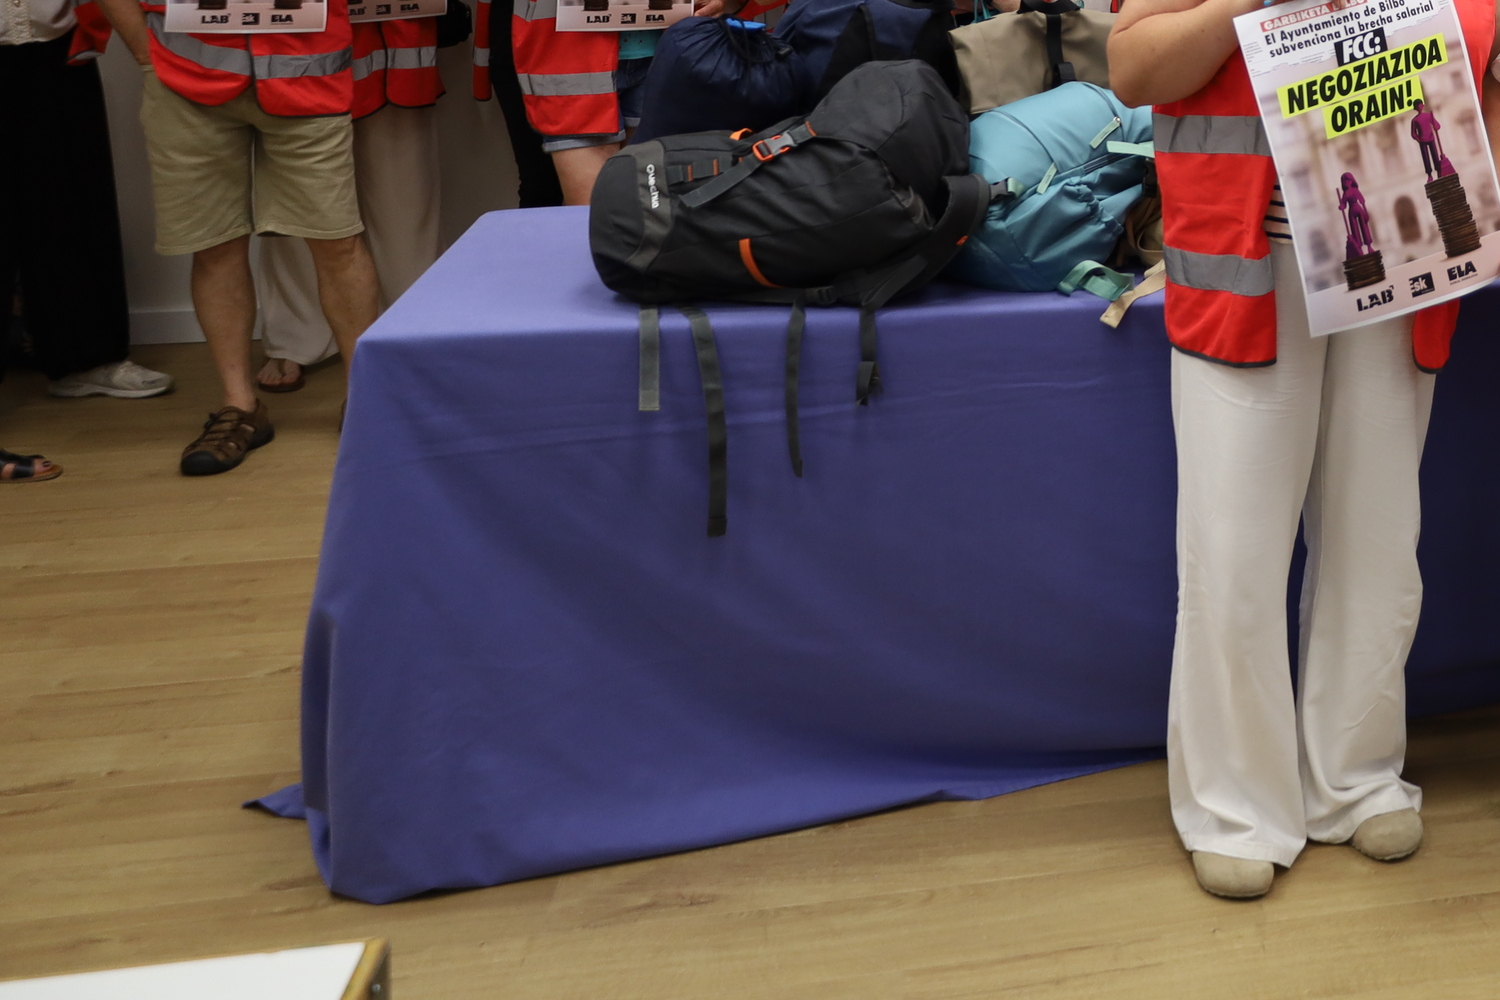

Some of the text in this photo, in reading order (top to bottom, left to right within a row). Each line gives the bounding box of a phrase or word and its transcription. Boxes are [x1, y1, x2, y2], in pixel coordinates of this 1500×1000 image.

[201, 14, 229, 24] LAB
[271, 14, 293, 23] ELA
[350, 8, 365, 16] AB
[586, 14, 611, 23] LAB
[646, 14, 665, 22] ELA
[1264, 5, 1330, 31] GARBIKETA
[1265, 33, 1276, 45] El
[1280, 12, 1360, 47] Ayuntamiento
[1364, 6, 1377, 17] de
[1270, 30, 1341, 58] subvenciona
[1345, 25, 1355, 37] la
[1358, 14, 1393, 32] brecha
[1396, 0, 1434, 20] salarial
[1342, 33, 1382, 64] FCC:
[1287, 38, 1442, 114] NEGOZIAZIOA
[1331, 80, 1413, 132] ORAIN!
[646, 164, 660, 209] Quechua
[1356, 287, 1394, 312] LAB
[1447, 261, 1477, 281] ELA
